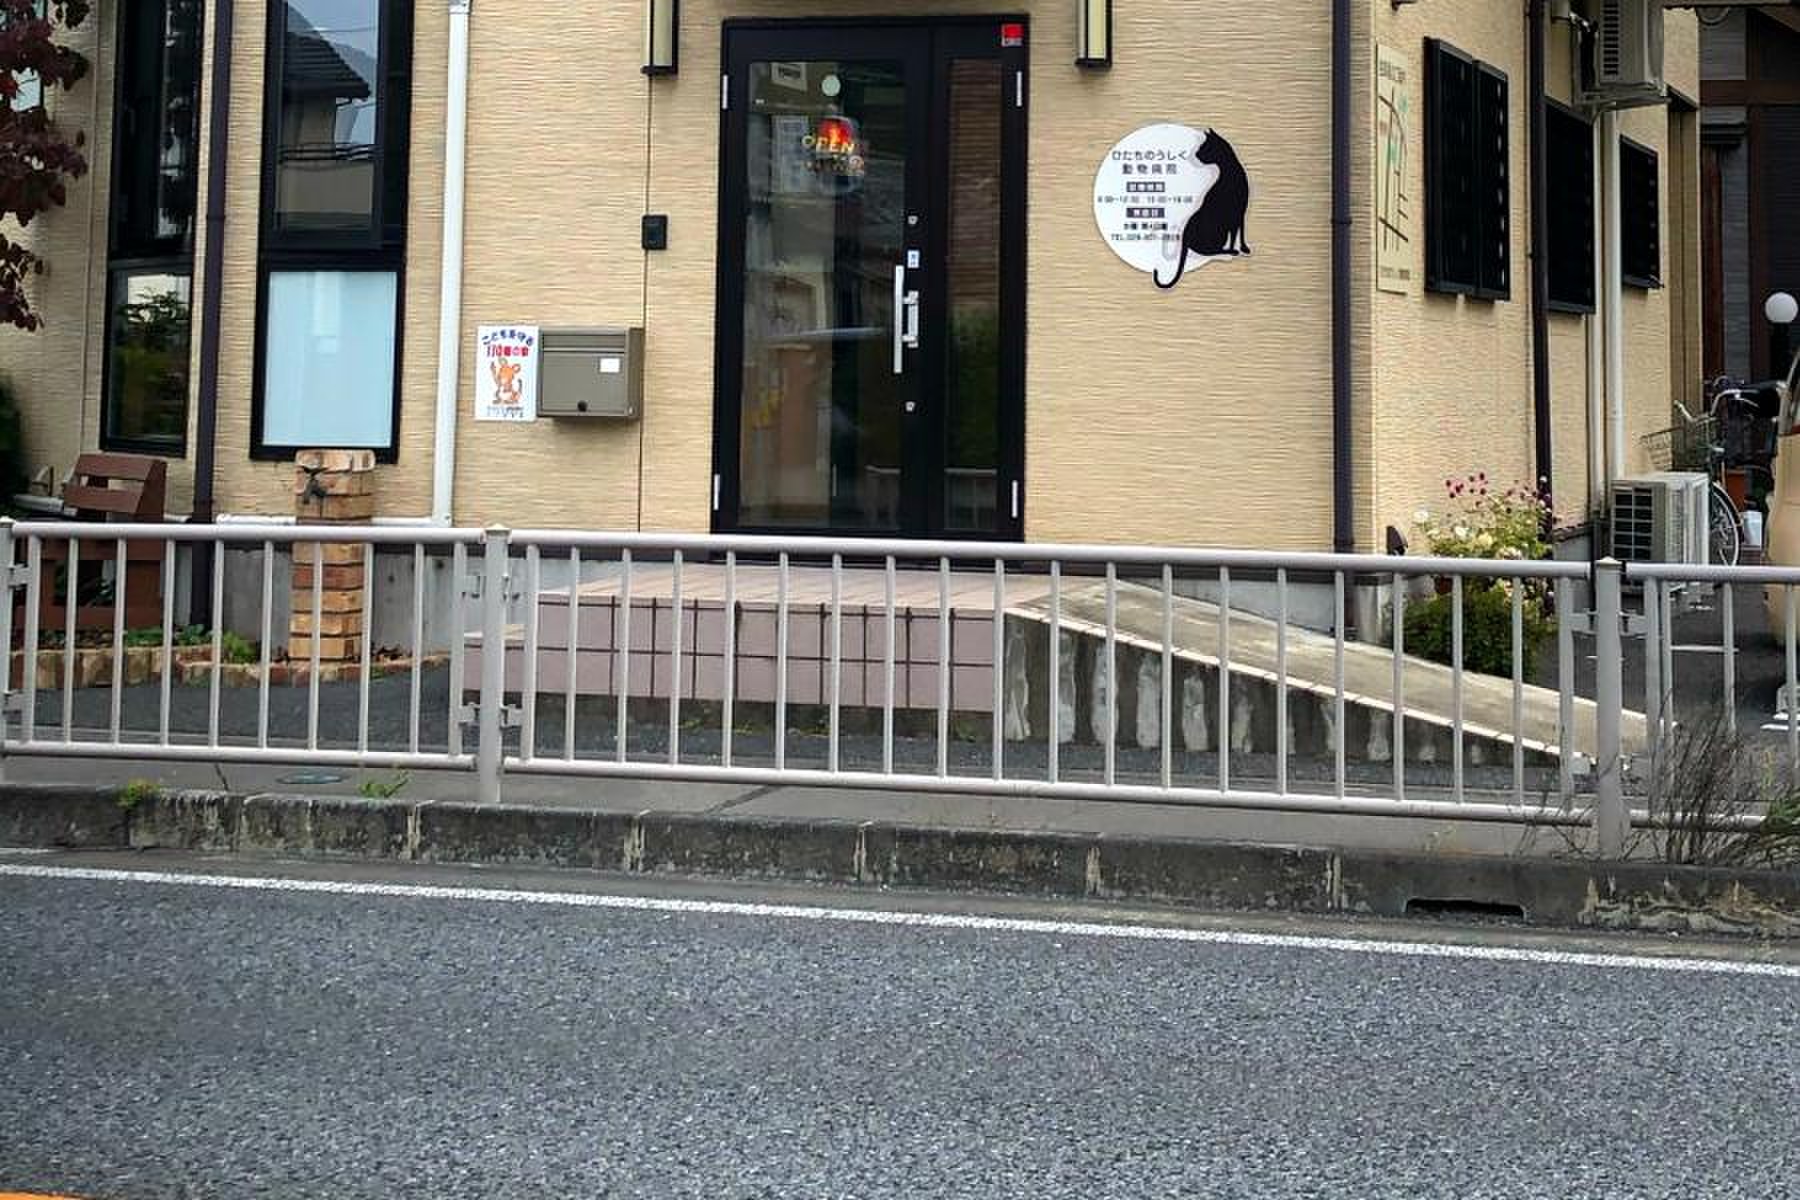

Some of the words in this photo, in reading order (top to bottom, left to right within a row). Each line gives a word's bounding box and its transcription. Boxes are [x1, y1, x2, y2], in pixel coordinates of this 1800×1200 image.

[801, 135, 855, 155] OPEN
[1112, 150, 1187, 160] ひたちのうしく
